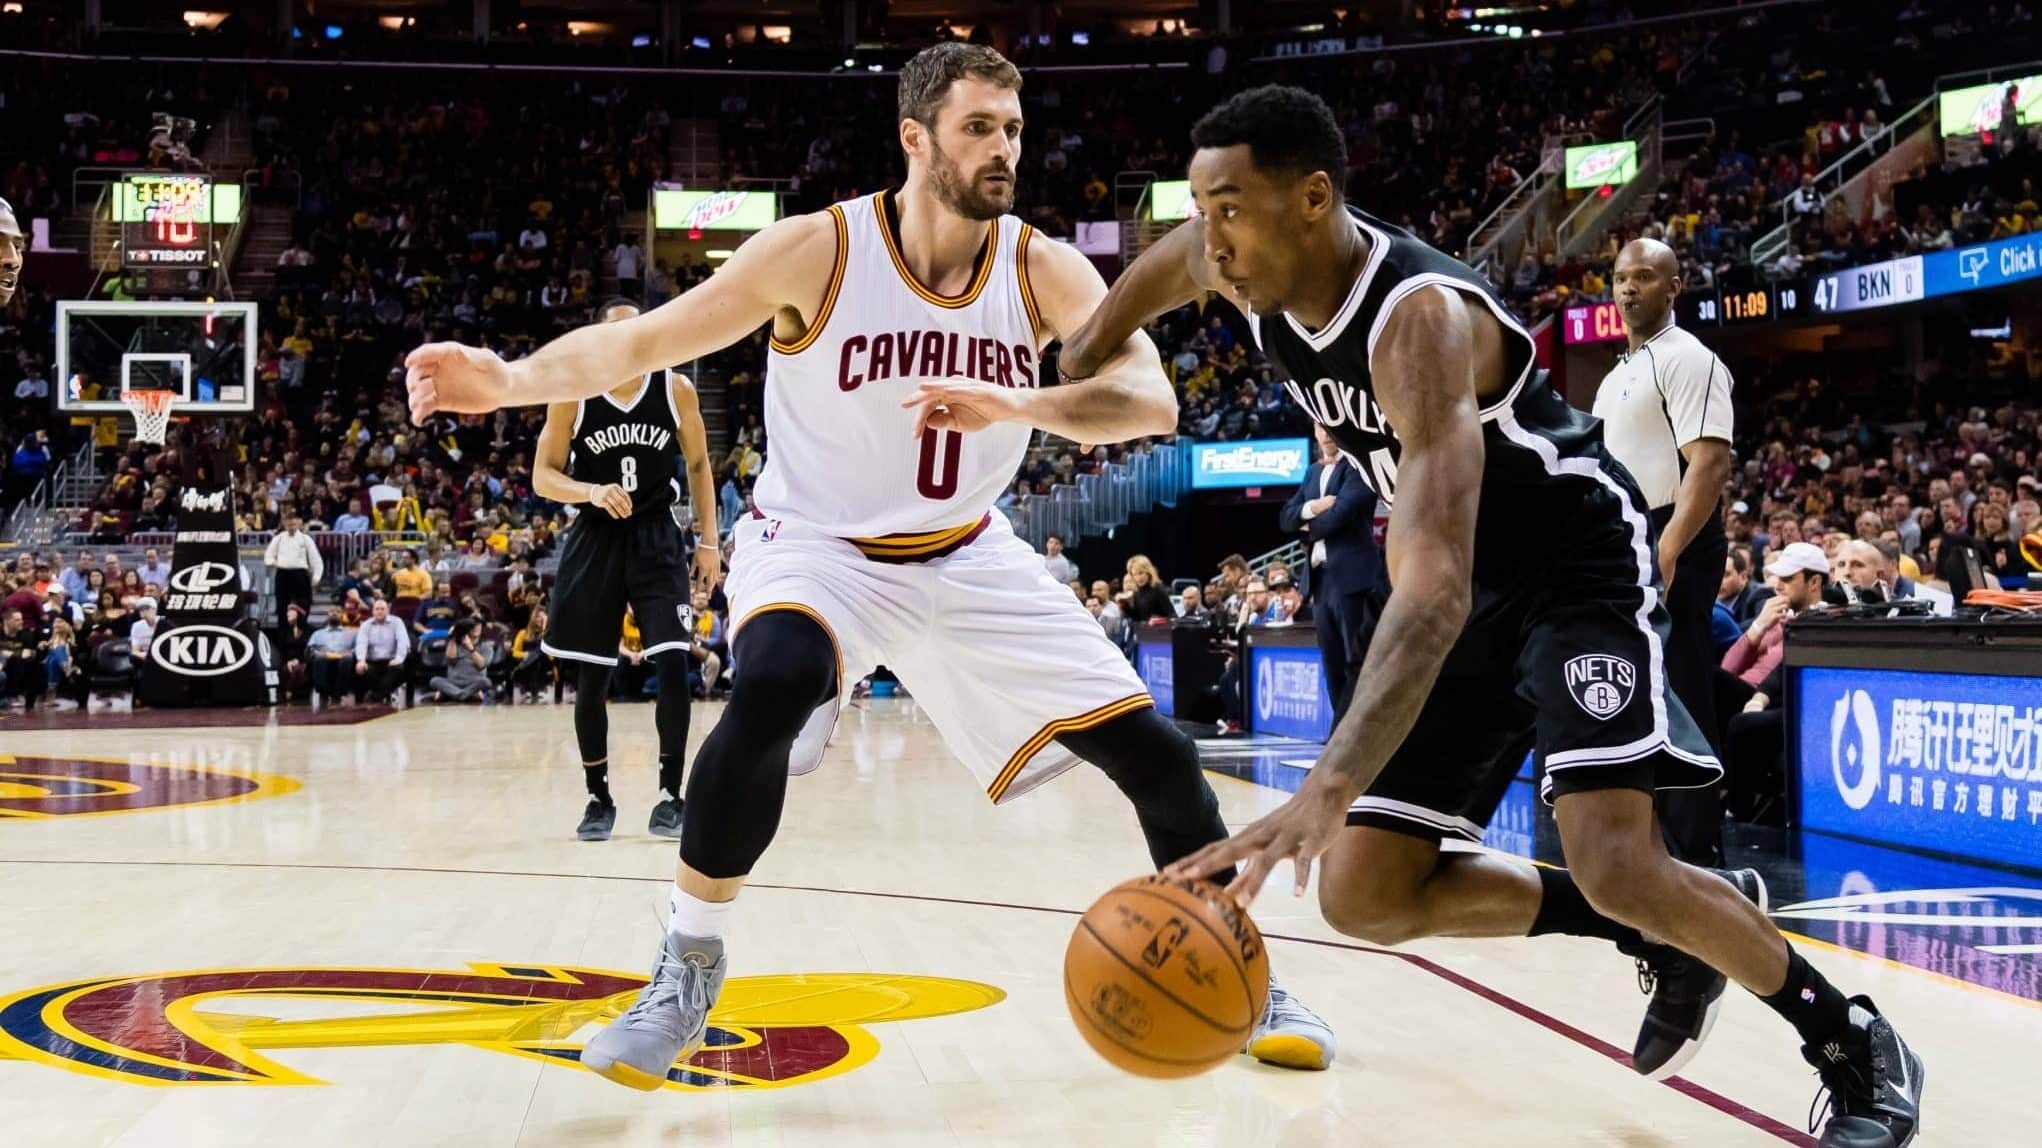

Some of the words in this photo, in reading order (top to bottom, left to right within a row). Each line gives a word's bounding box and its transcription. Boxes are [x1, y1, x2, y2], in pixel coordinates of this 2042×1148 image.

[2000, 243, 2036, 277] Click
[1724, 291, 1767, 319] 11:09
[1781, 289, 1796, 310] 10
[1814, 277, 1838, 311] 47
[1858, 269, 1890, 301] BKN
[838, 330, 1035, 392] CAVALIERS
[584, 423, 671, 455] BROOKLYN
[620, 456, 638, 492] 8
[169, 636, 237, 664] KIA
[1569, 657, 1632, 687] NETS
[1887, 699, 2042, 782] 腾讯理财
